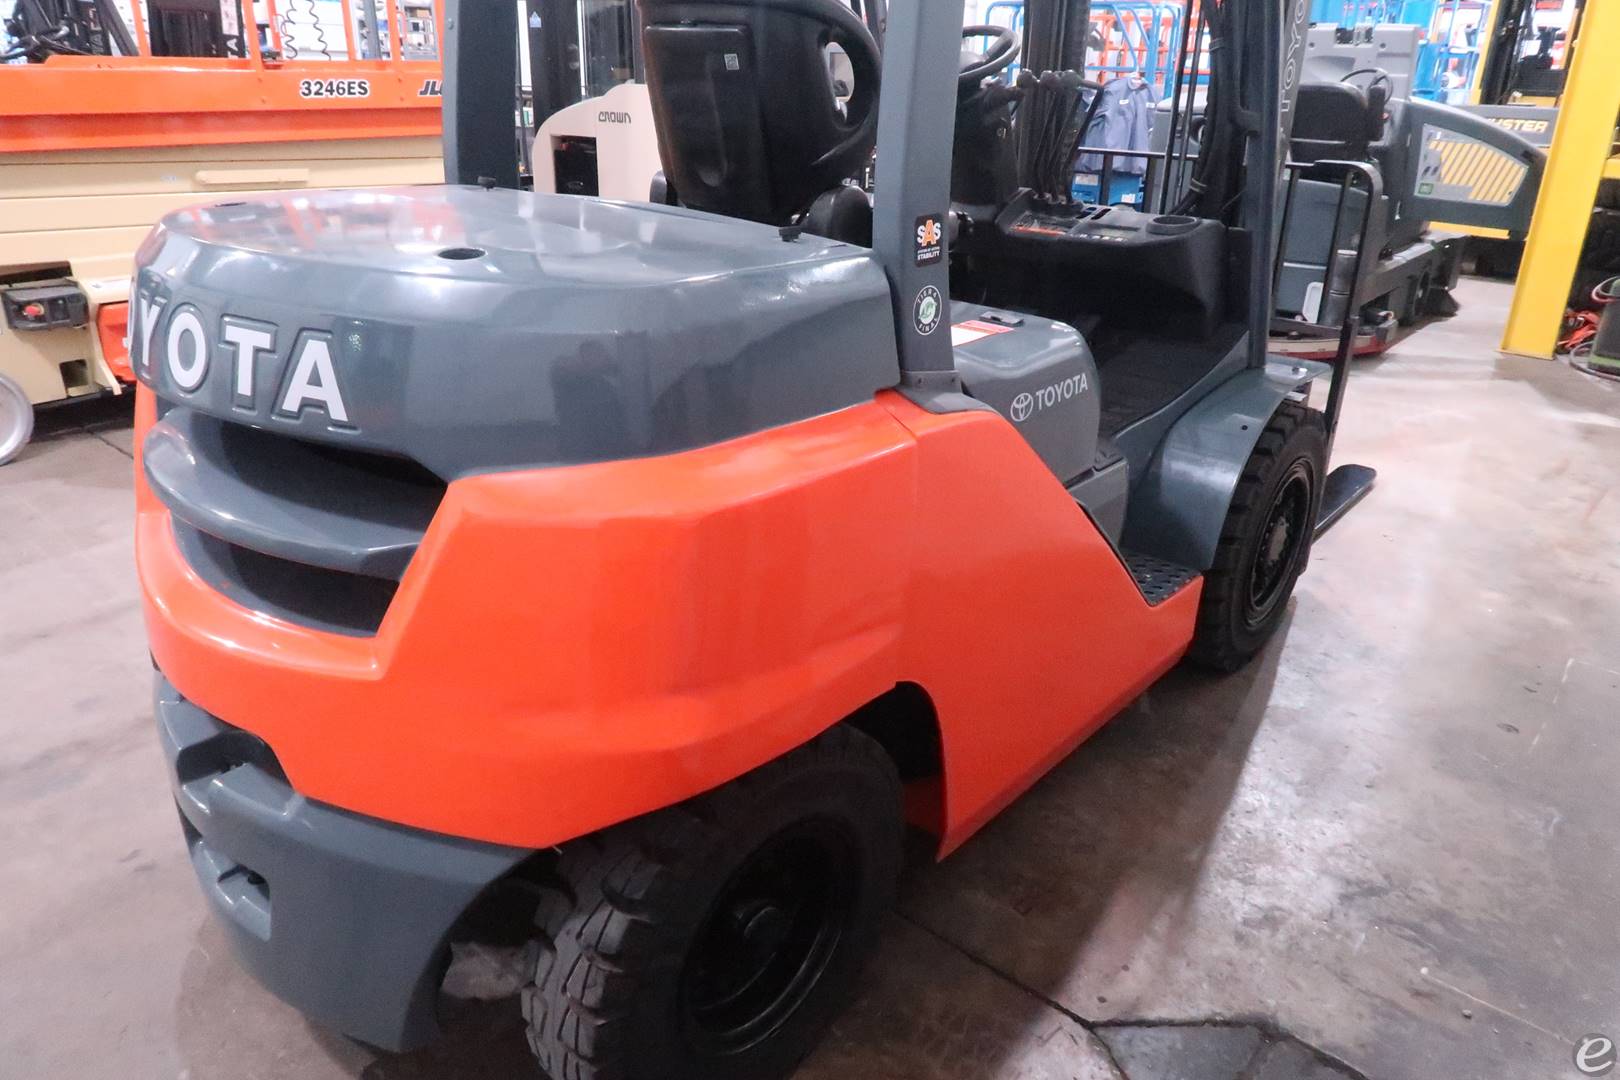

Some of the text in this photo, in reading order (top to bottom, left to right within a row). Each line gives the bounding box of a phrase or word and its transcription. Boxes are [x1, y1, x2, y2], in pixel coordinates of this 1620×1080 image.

[300, 79, 369, 97] 3246ES
[598, 111, 632, 124] CROWN
[916, 219, 942, 247] SAS
[917, 250, 940, 261] STABILITY
[137, 296, 350, 423] YOTA
[1036, 372, 1088, 410] TOYOTA
